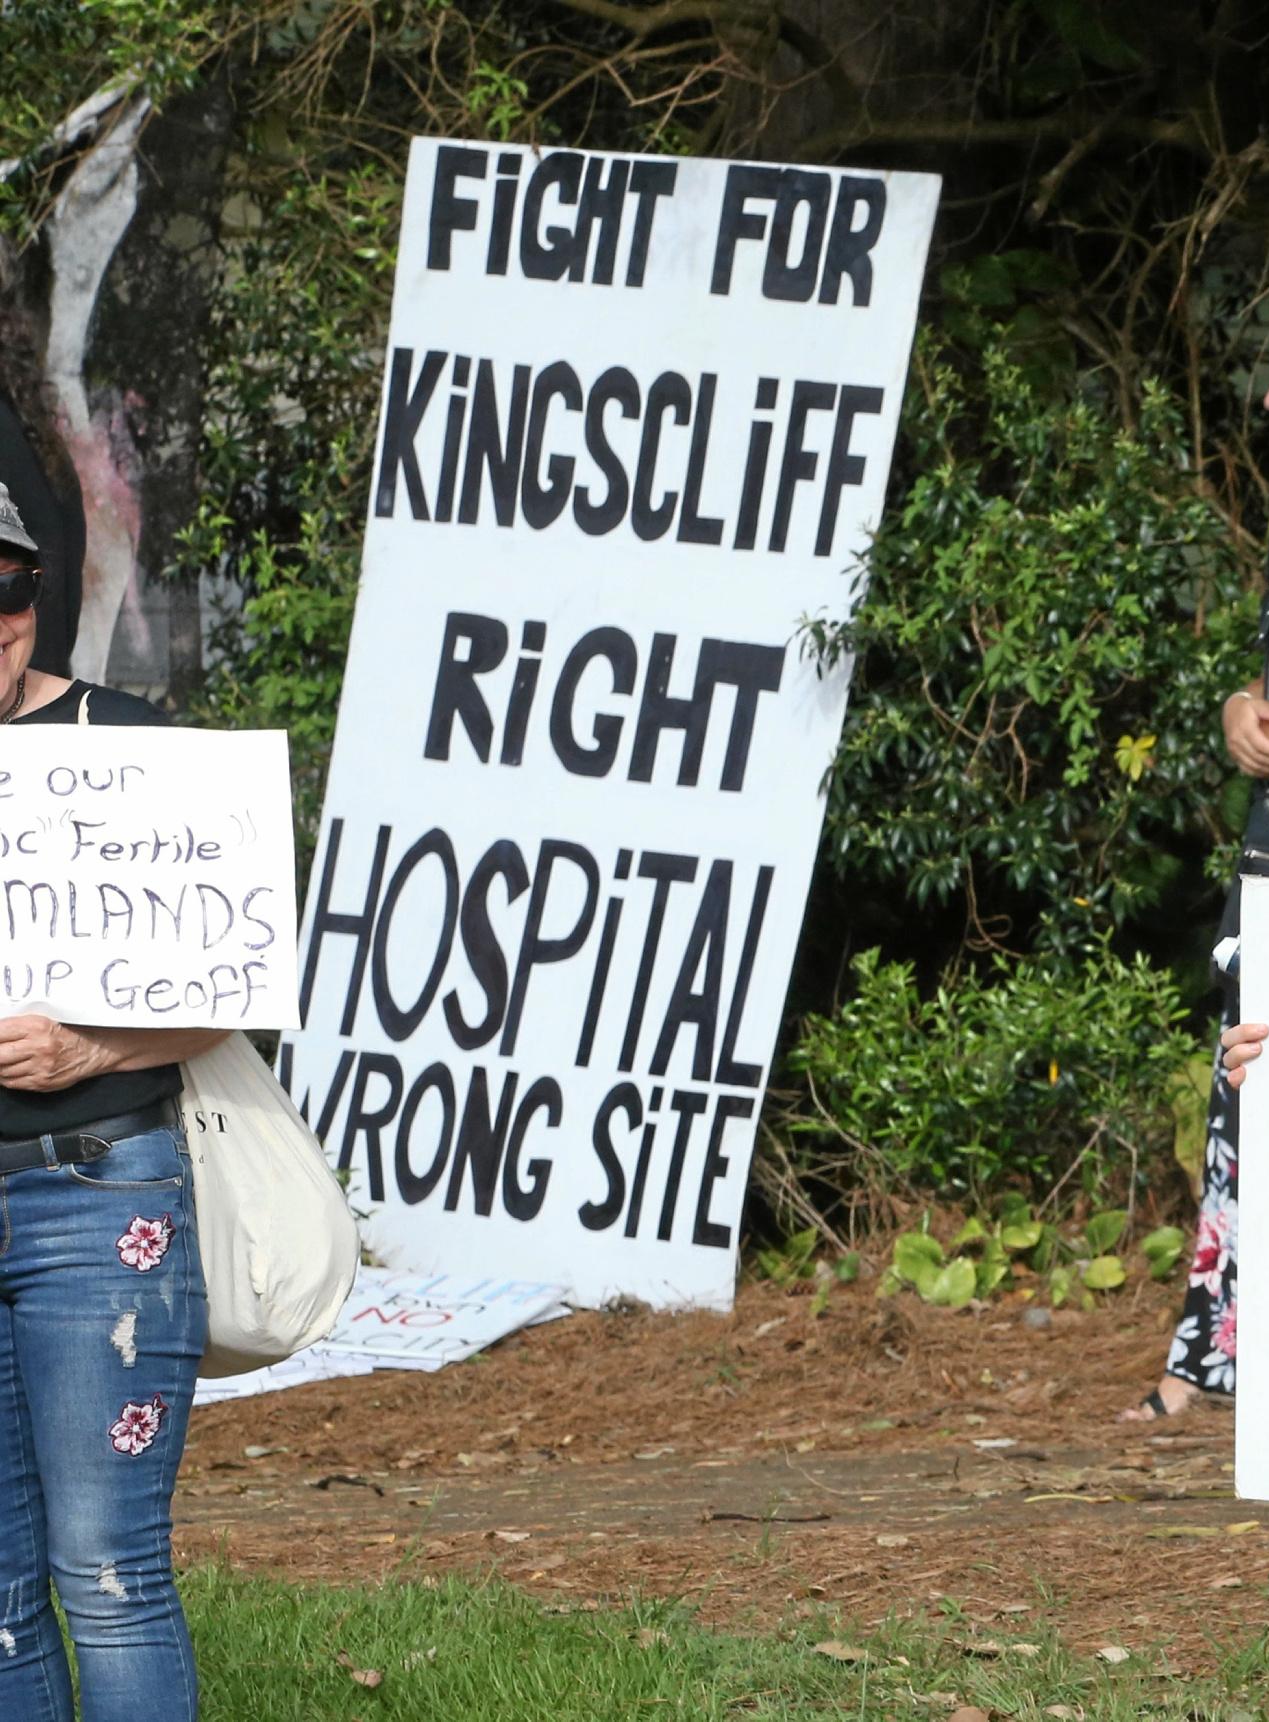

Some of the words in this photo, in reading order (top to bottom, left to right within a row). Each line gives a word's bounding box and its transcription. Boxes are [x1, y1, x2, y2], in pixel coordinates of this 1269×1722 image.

[710, 164, 888, 308] FOR
[46, 765, 145, 797] our
[350, 1306, 454, 1328] NO
